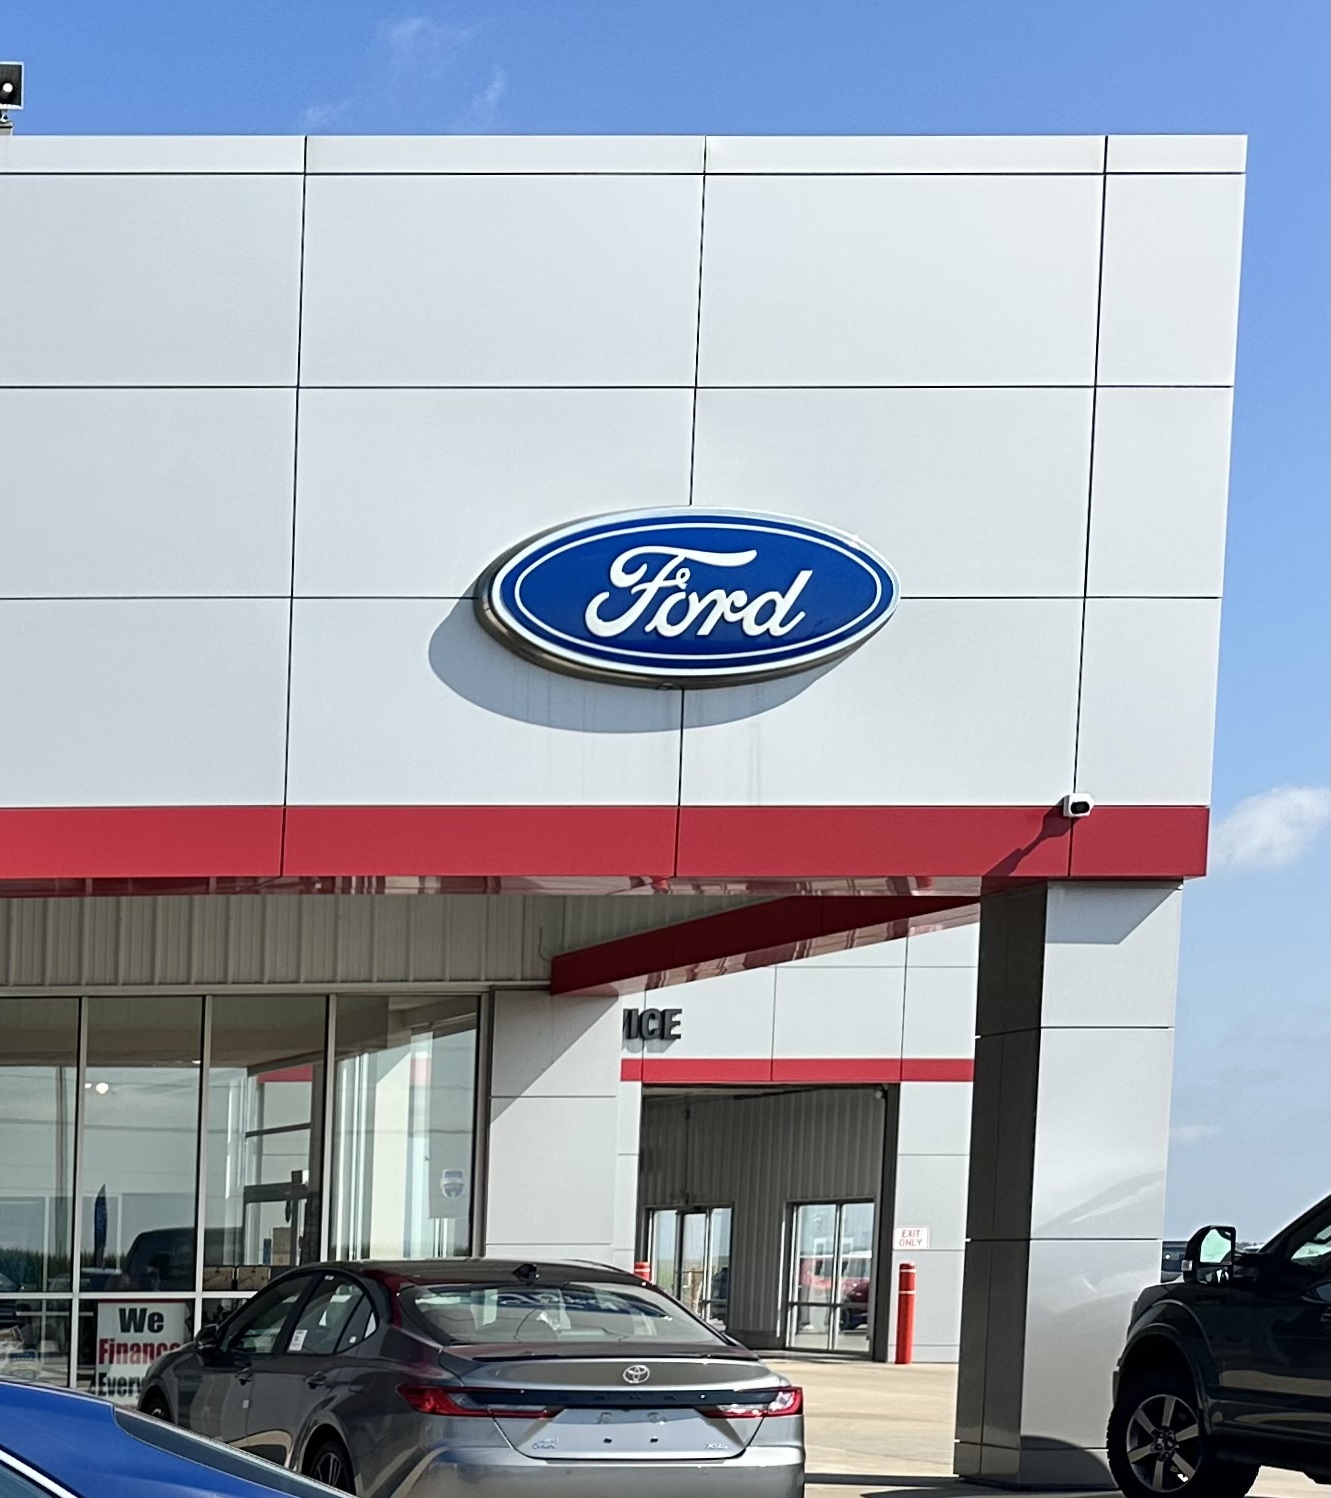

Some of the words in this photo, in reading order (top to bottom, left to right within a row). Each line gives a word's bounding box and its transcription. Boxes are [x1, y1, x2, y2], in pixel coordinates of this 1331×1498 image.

[584, 545, 814, 638] Ford
[899, 1238, 923, 1247] ONLY
[901, 1229, 921, 1238] EXIT
[119, 1307, 164, 1334] We
